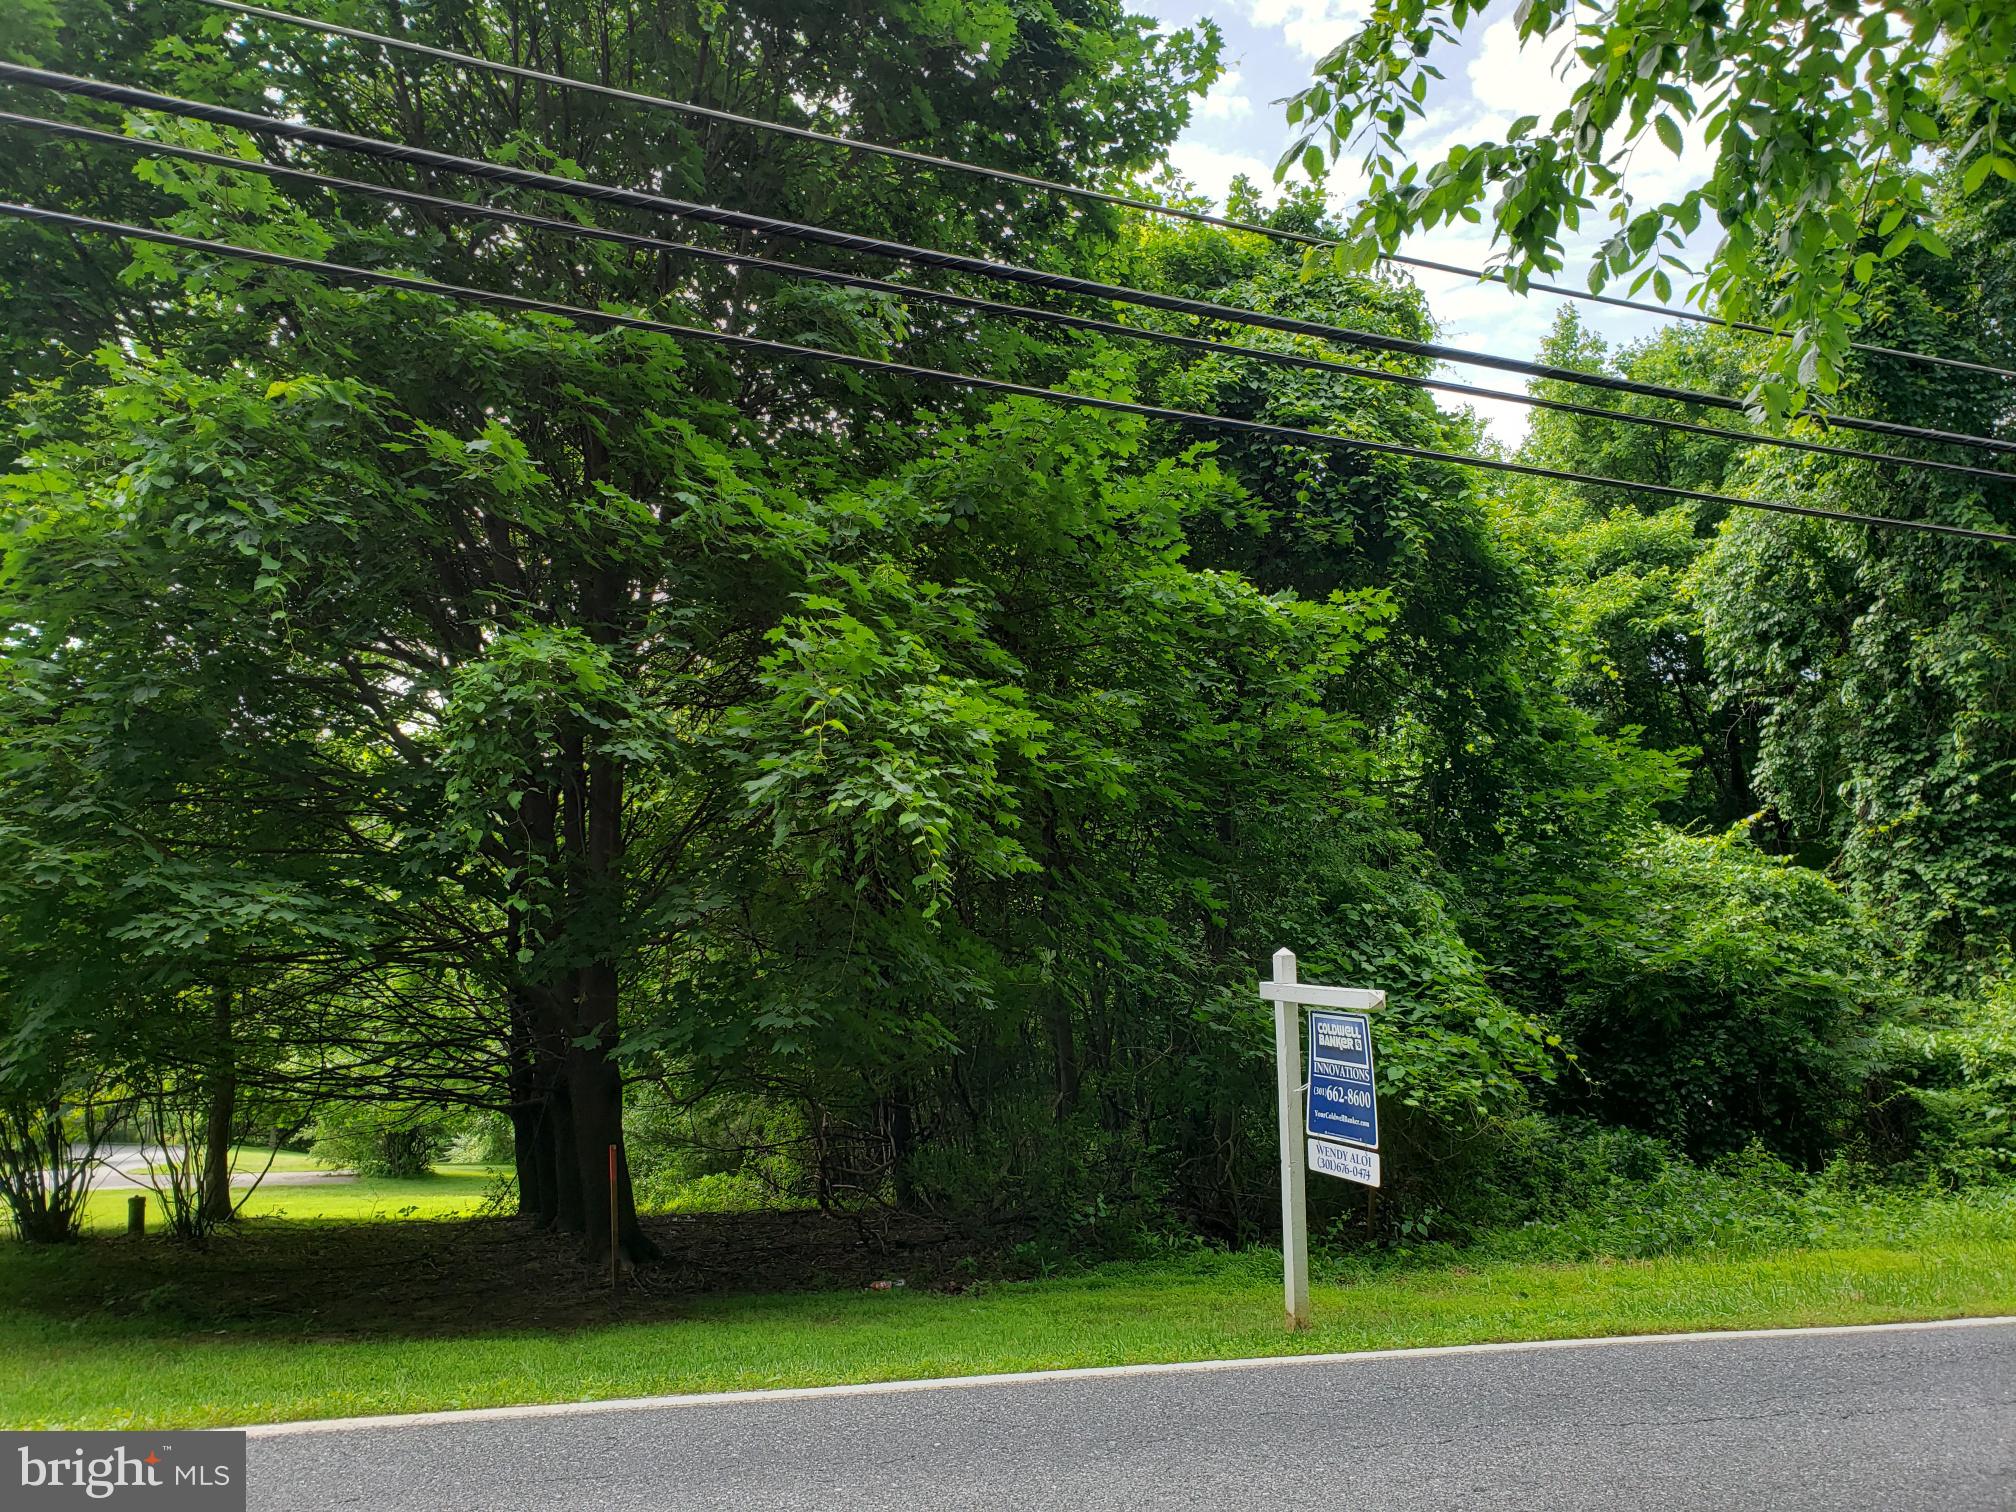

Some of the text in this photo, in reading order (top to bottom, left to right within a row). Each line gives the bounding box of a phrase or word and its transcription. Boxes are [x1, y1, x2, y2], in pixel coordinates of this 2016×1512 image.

[1317, 1022, 1362, 1039] COLDWELL
[1318, 1033, 1354, 1051] BANKER
[1314, 1061, 1370, 1082] INNOVATIONS
[1316, 1144, 1371, 1167] WENDY ALOI
